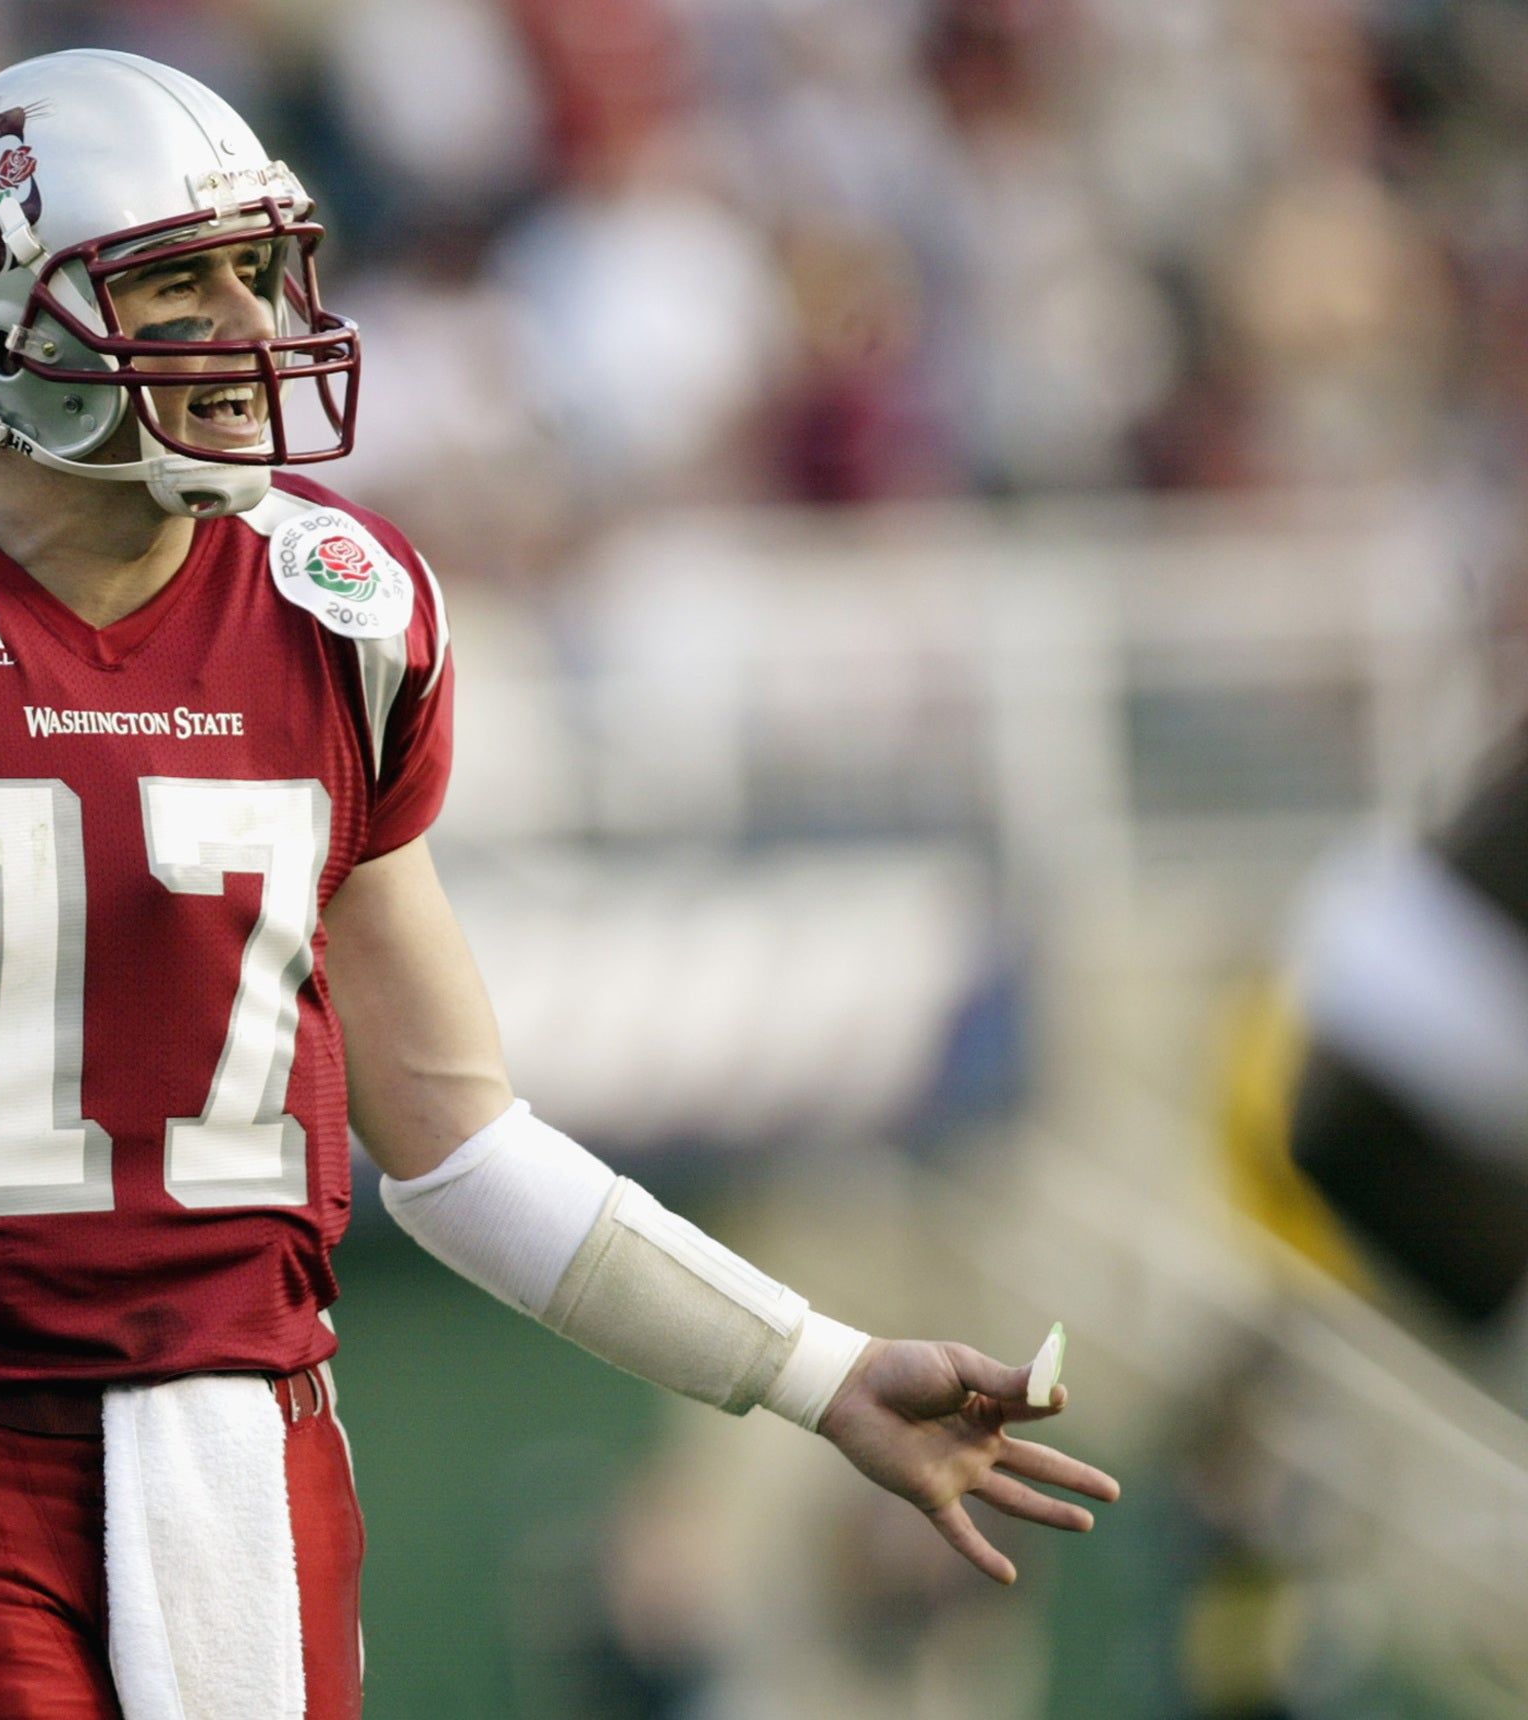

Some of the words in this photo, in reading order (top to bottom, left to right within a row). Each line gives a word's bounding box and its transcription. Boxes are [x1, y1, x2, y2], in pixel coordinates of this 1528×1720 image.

[280, 528, 303, 579] ROSE
[300, 514, 355, 533] BOW
[23, 706, 171, 738] WASHINGTON
[174, 707, 244, 740] STATE
